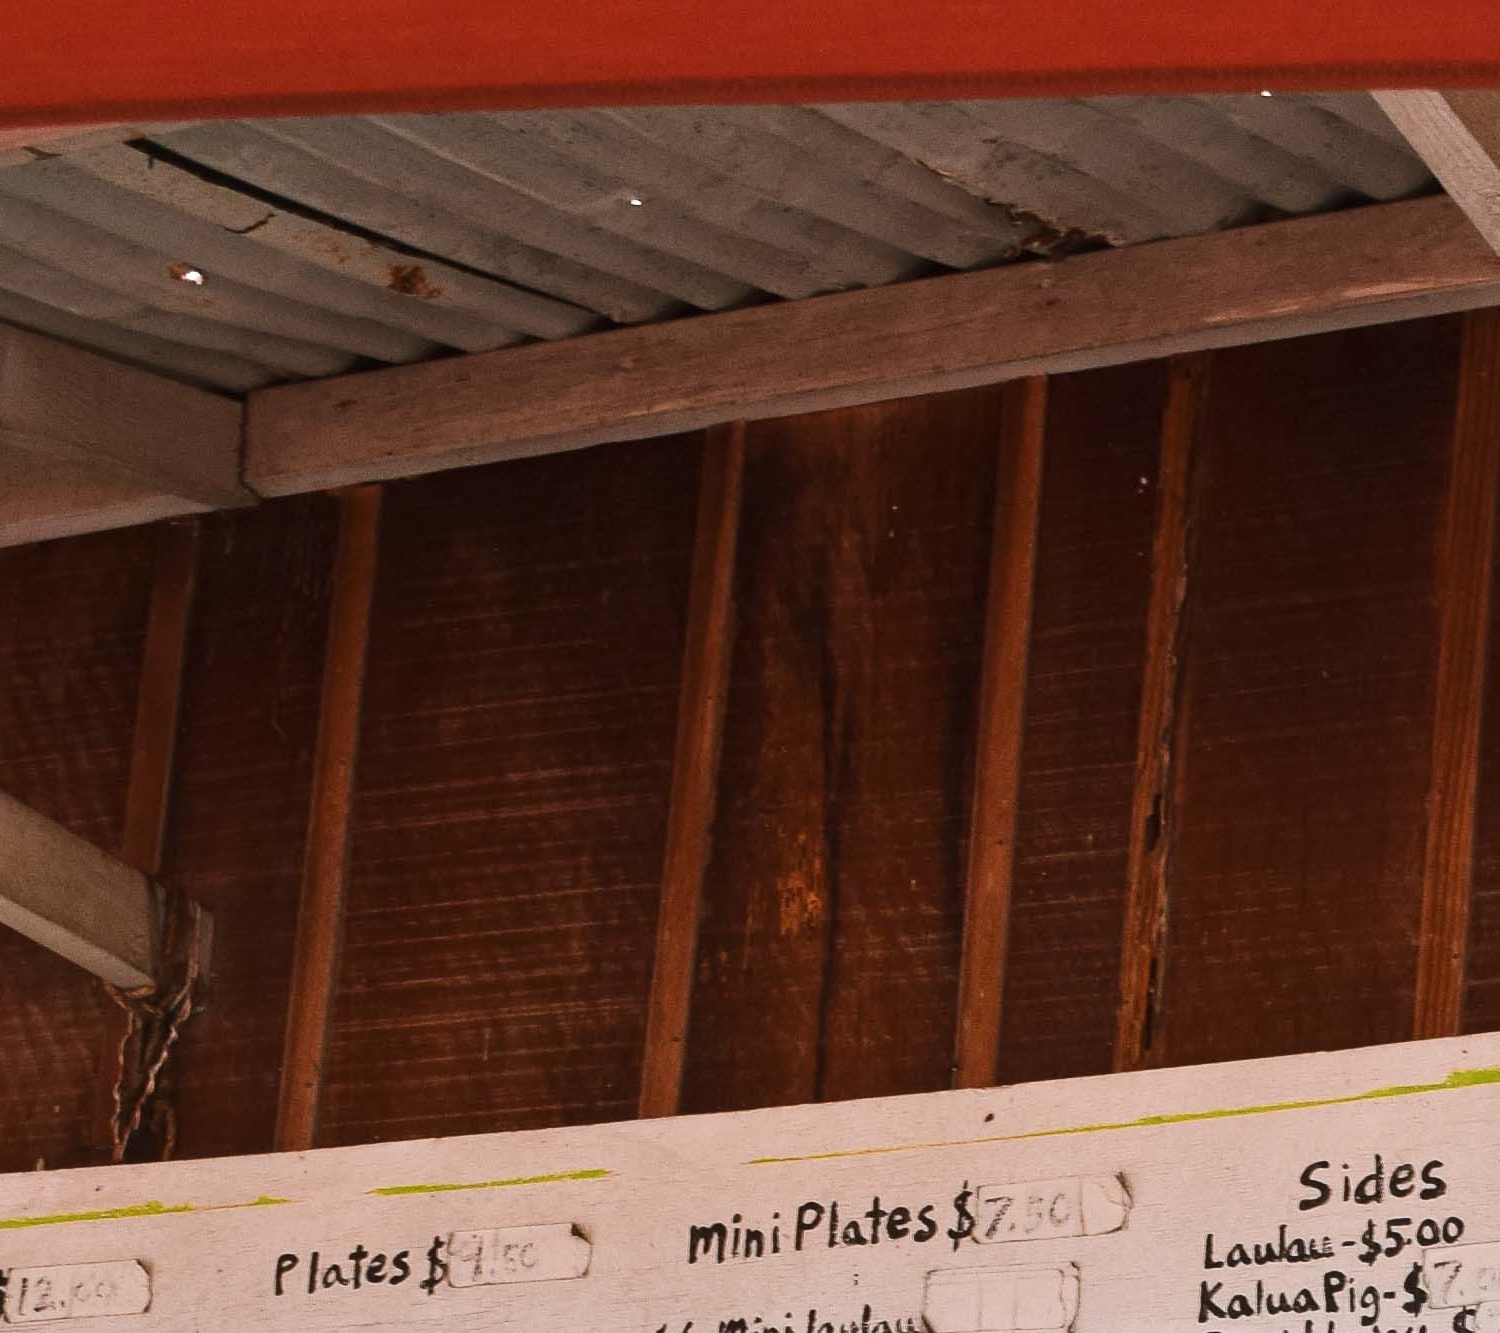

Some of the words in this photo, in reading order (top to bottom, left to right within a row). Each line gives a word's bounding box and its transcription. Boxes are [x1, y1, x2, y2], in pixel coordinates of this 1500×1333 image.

[1298, 1153, 1447, 1212] Sides
[794, 1196, 938, 1252] Plates
[1203, 1223, 1335, 1270] Laulau
[274, 1244, 411, 1297] Plates
[1197, 1279, 1321, 1329] Kalua
